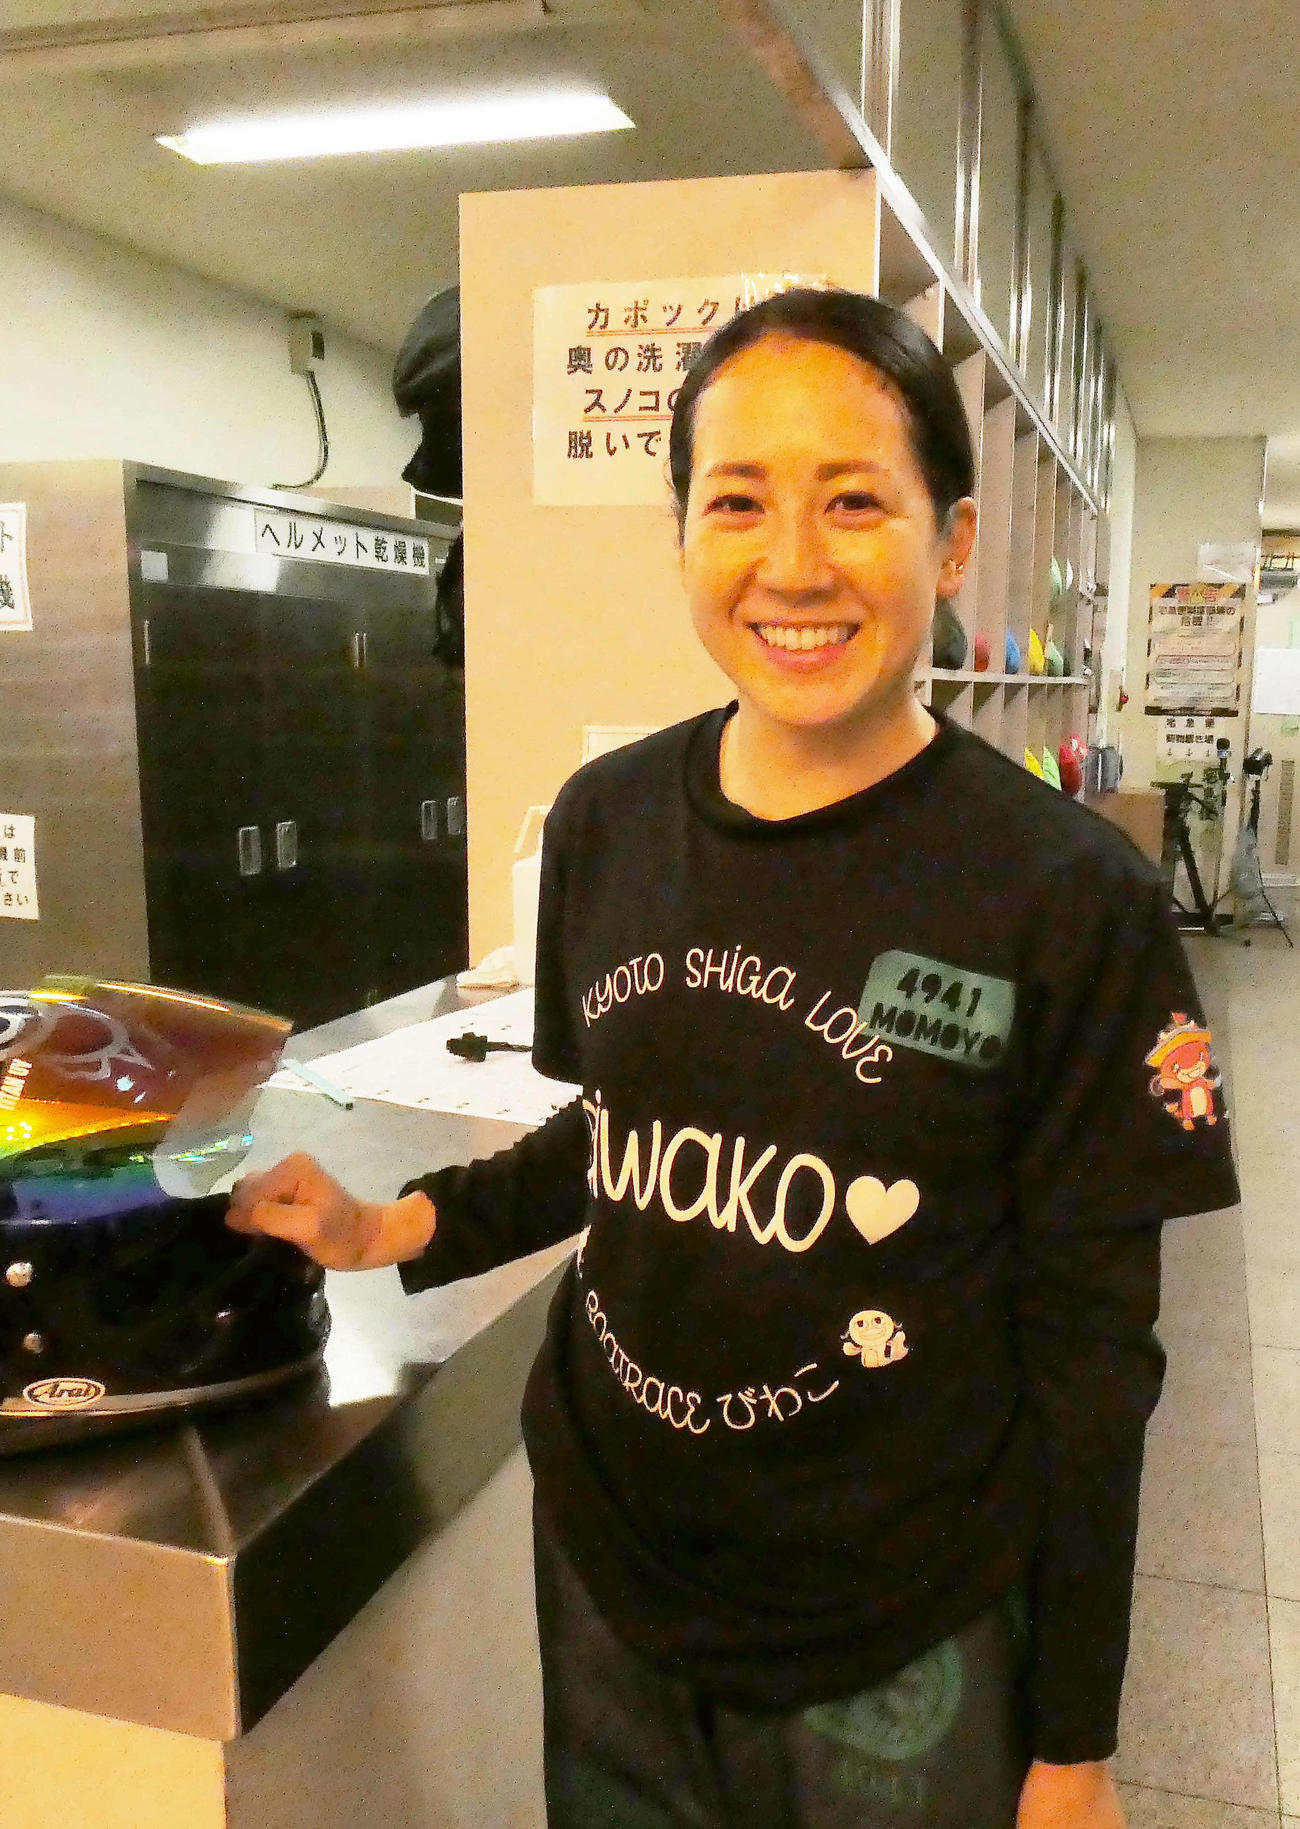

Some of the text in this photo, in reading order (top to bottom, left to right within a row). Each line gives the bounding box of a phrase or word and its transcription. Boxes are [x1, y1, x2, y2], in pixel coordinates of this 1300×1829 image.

[567, 429, 662, 459] 脱いで
[261, 521, 426, 569] ヘルメット乾燥機
[898, 967, 983, 1018] 4941
[804, 990, 894, 1084] LOVE
[869, 1001, 1003, 1060] MOMOYO
[716, 1362, 840, 1431] びわこ
